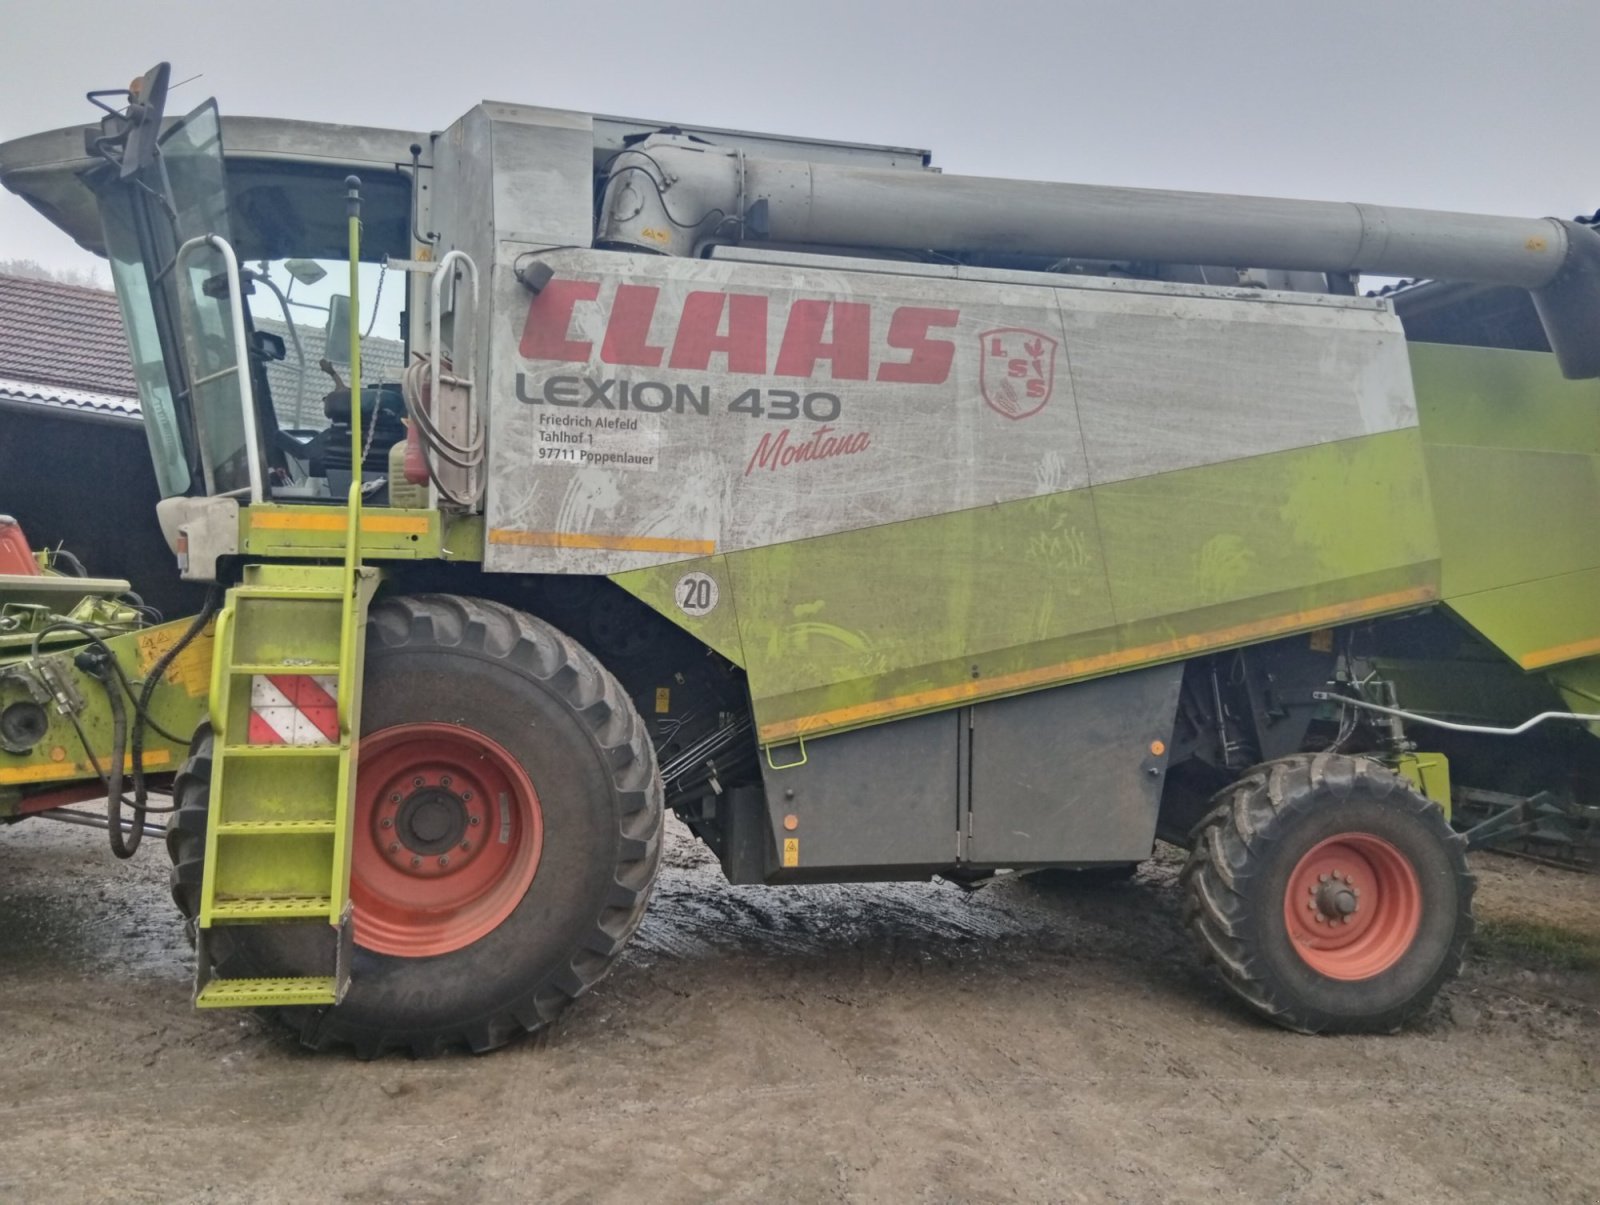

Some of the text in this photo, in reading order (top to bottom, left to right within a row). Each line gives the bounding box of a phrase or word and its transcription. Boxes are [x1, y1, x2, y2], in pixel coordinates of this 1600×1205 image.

[518, 279, 960, 385] CLAAS
[515, 373, 841, 422] LEXION 430
[539, 413, 638, 430] Friedrich Alefeld
[539, 430, 593, 445] Tahlhof 1
[539, 447, 654, 465] 97711 Poppenlauer
[745, 425, 871, 477] Montana
[683, 578, 711, 610] 20
